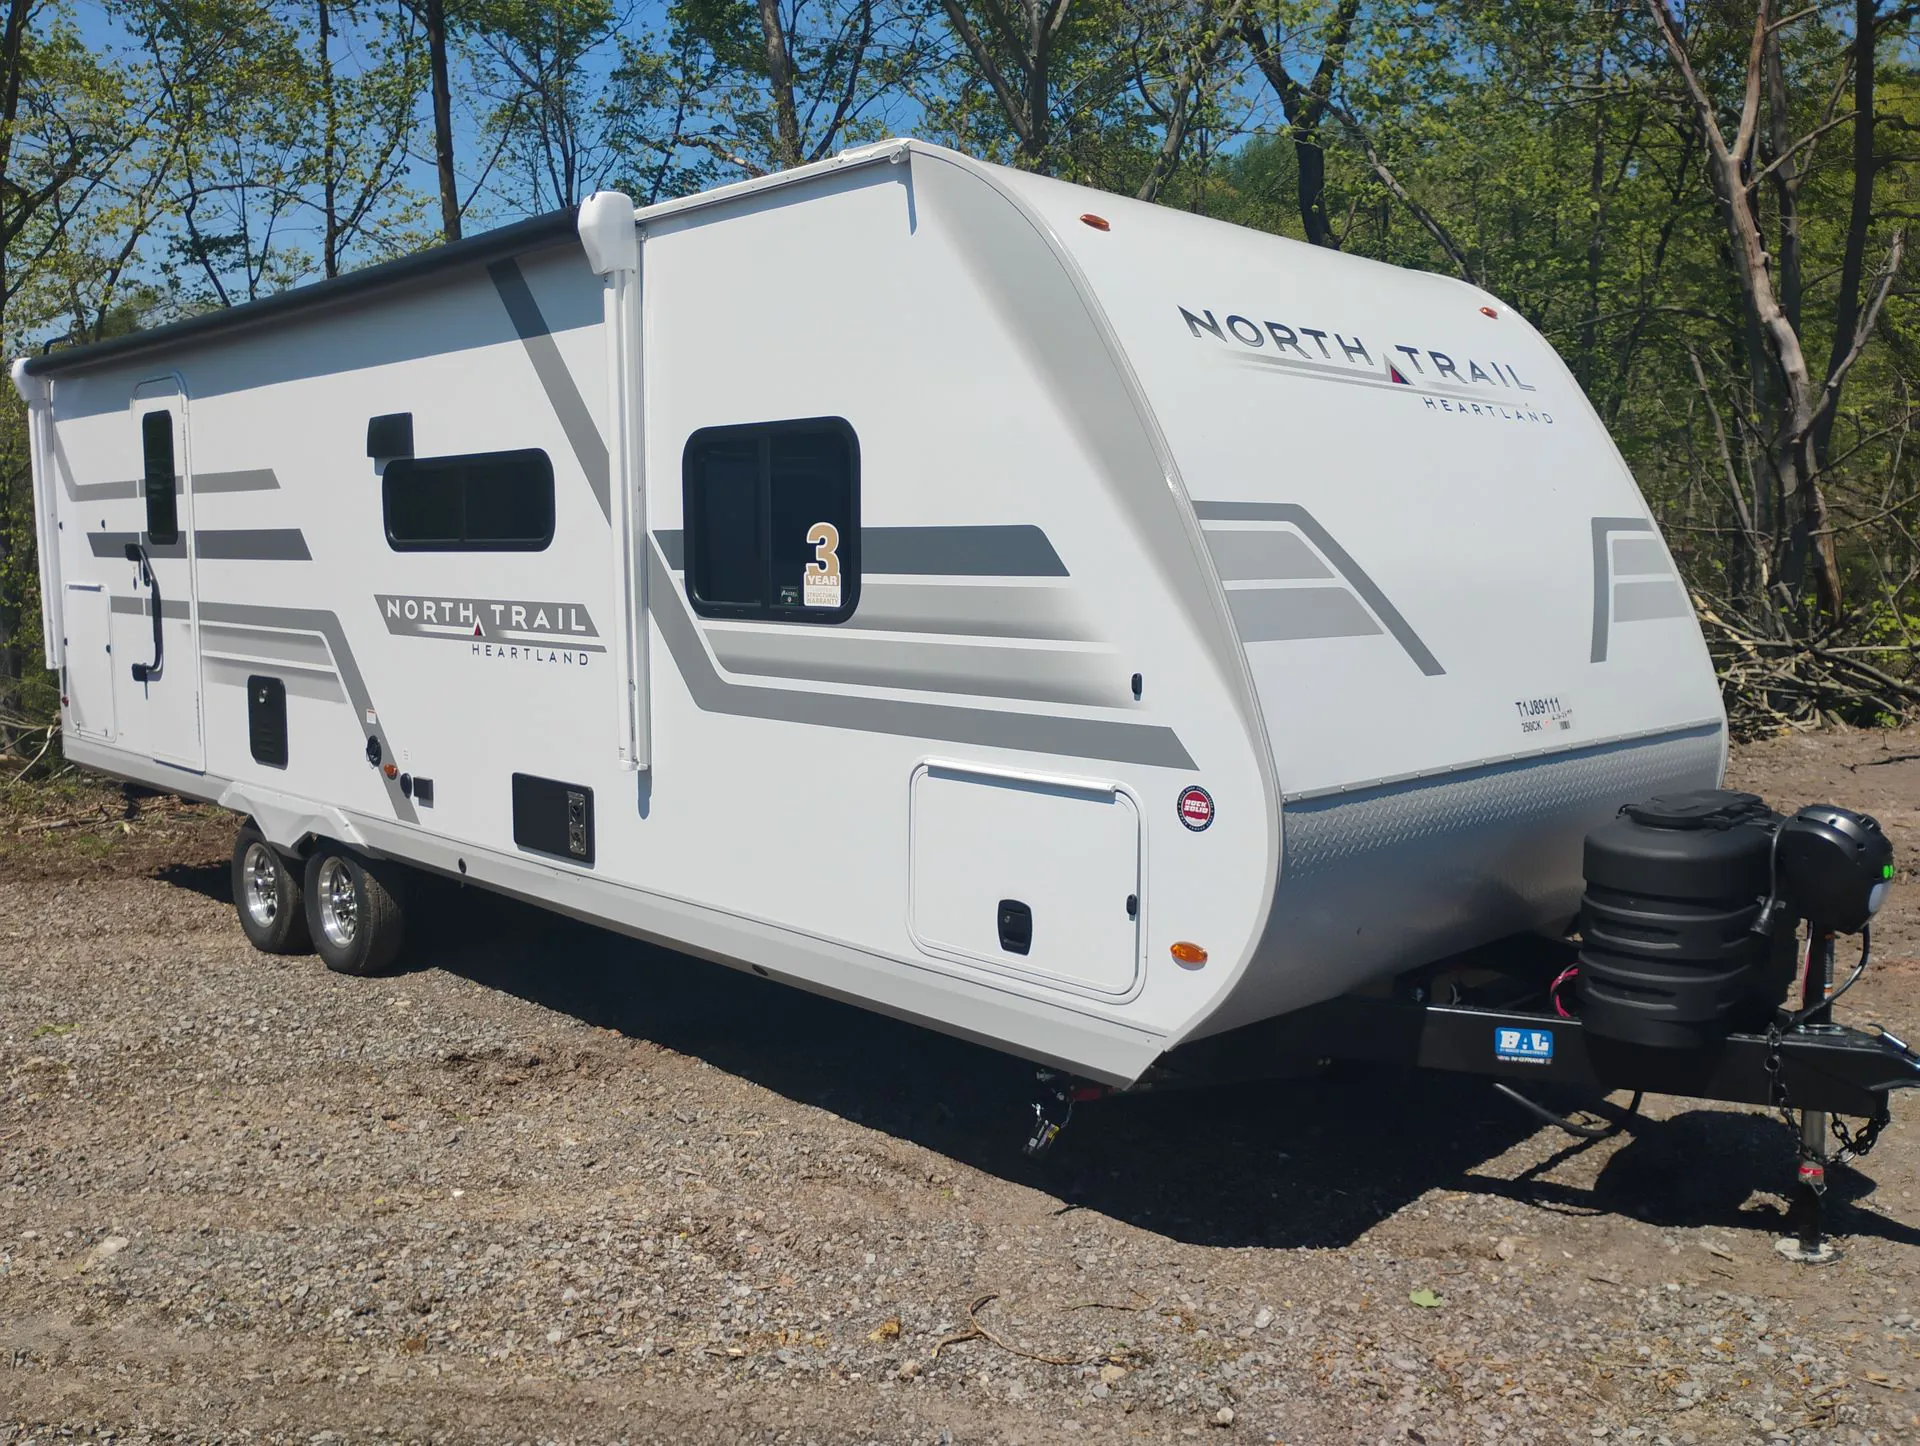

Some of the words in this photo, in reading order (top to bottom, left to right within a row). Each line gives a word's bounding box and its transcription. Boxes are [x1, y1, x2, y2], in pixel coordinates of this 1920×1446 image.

[1177, 304, 1374, 366] NORTH
[1394, 344, 1537, 392] TRAIL
[1422, 396, 1554, 425] HEARTLAND
[806, 521, 840, 577] 3
[807, 575, 838, 586] YEAR
[386, 599, 474, 624] NORTH
[490, 604, 586, 632] TRAIL
[472, 643, 589, 666] HEARTLAND
[1515, 696, 1561, 717] T1J89111
[1183, 805, 1209, 814] SOLID
[1185, 799, 1208, 808] ROCK
